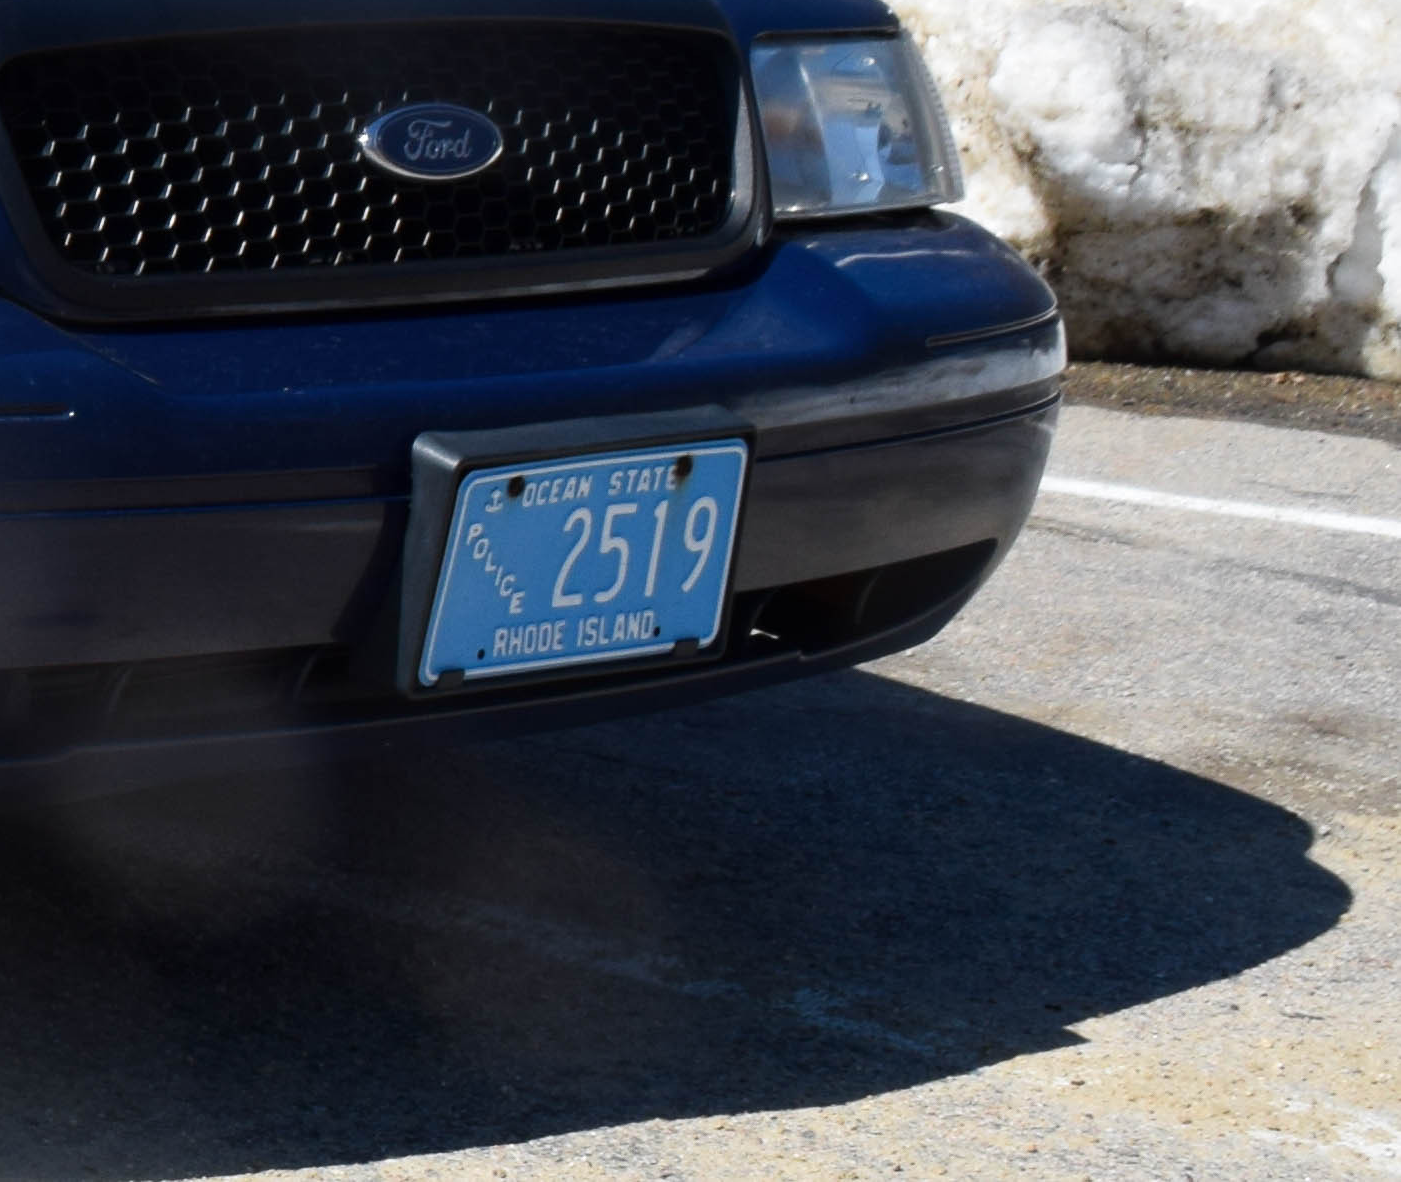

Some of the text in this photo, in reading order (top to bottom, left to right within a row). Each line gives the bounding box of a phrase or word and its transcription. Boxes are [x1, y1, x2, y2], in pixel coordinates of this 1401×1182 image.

[403, 119, 472, 161] Ford
[521, 466, 678, 508] OCEAN STATE
[465, 522, 526, 614] POLICE
[551, 496, 718, 608] 2519
[492, 609, 656, 658] RHODE ISLAND
